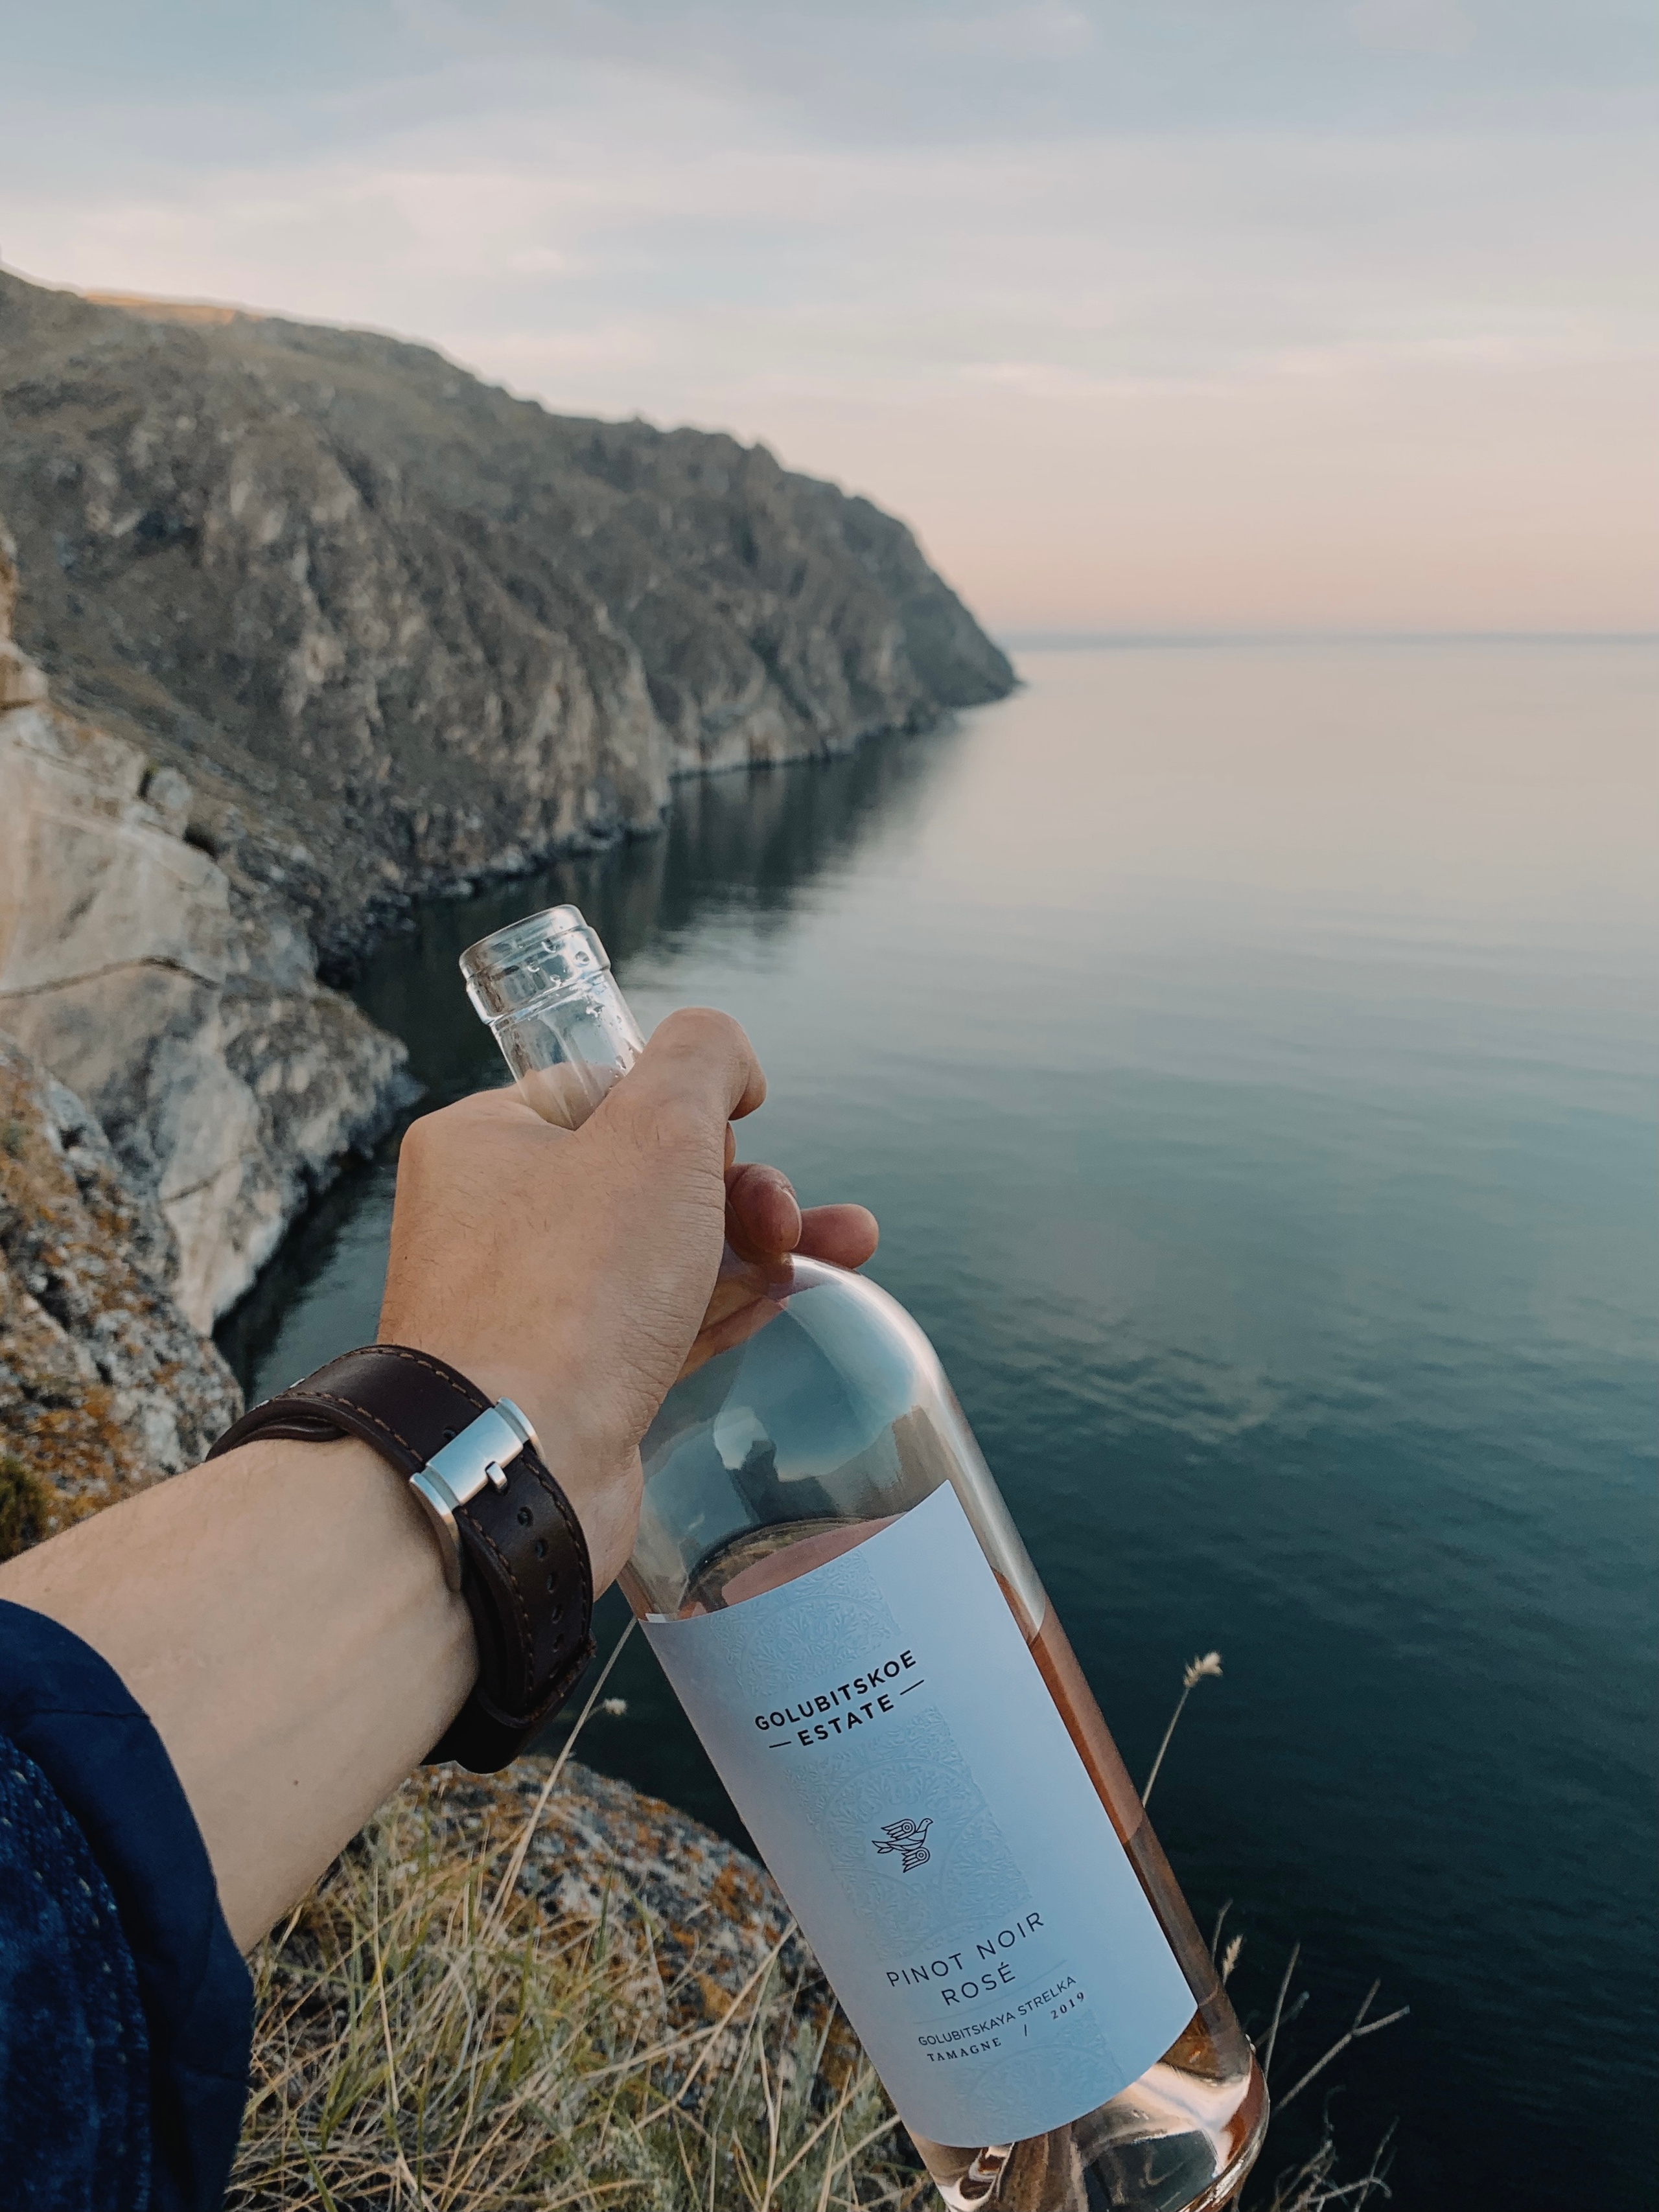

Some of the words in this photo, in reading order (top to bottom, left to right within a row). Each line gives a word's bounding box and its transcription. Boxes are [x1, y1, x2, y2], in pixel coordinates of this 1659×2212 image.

[755, 1650, 916, 1731] GOLUBITSKOE
[797, 1694, 894, 1746] ESTATE
[886, 1953, 963, 1987] PINOT
[976, 1912, 1044, 1960] NOIR
[941, 1961, 1016, 2006] ROSÉ
[918, 2012, 1015, 2046] GOLUBITSKAYA
[1017, 1976, 1076, 2016] STRELKA
[927, 2037, 1002, 2062] TAMAGNE
[1050, 1992, 1085, 2020] 2019
